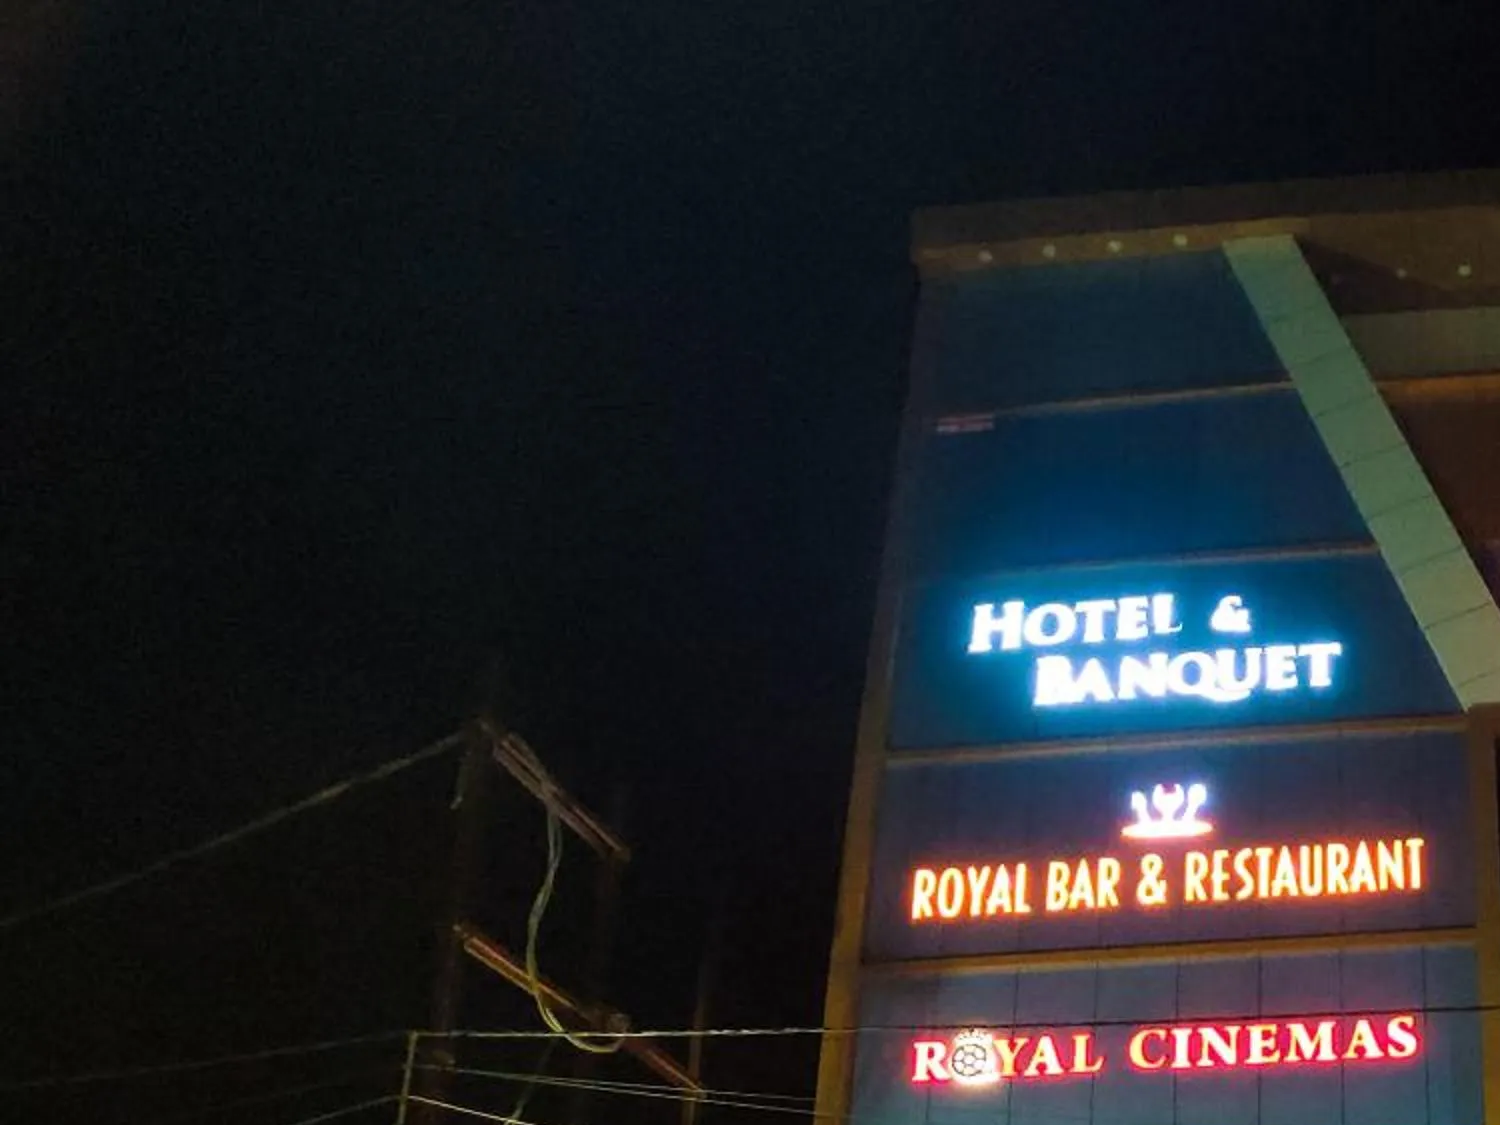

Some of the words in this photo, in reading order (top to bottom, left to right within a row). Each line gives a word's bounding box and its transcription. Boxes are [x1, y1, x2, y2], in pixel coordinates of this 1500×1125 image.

[967, 593, 1183, 653] HOTEL
[1209, 595, 1251, 633] &
[1032, 641, 1343, 707] BANQUET
[911, 862, 1032, 920] ROYAL
[1046, 855, 1122, 912] BAR
[1136, 853, 1168, 904] &
[1185, 837, 1425, 902] RESTAURANT
[911, 1028, 1104, 1085] ROYAL
[1128, 1015, 1419, 1069] CINEMAS
